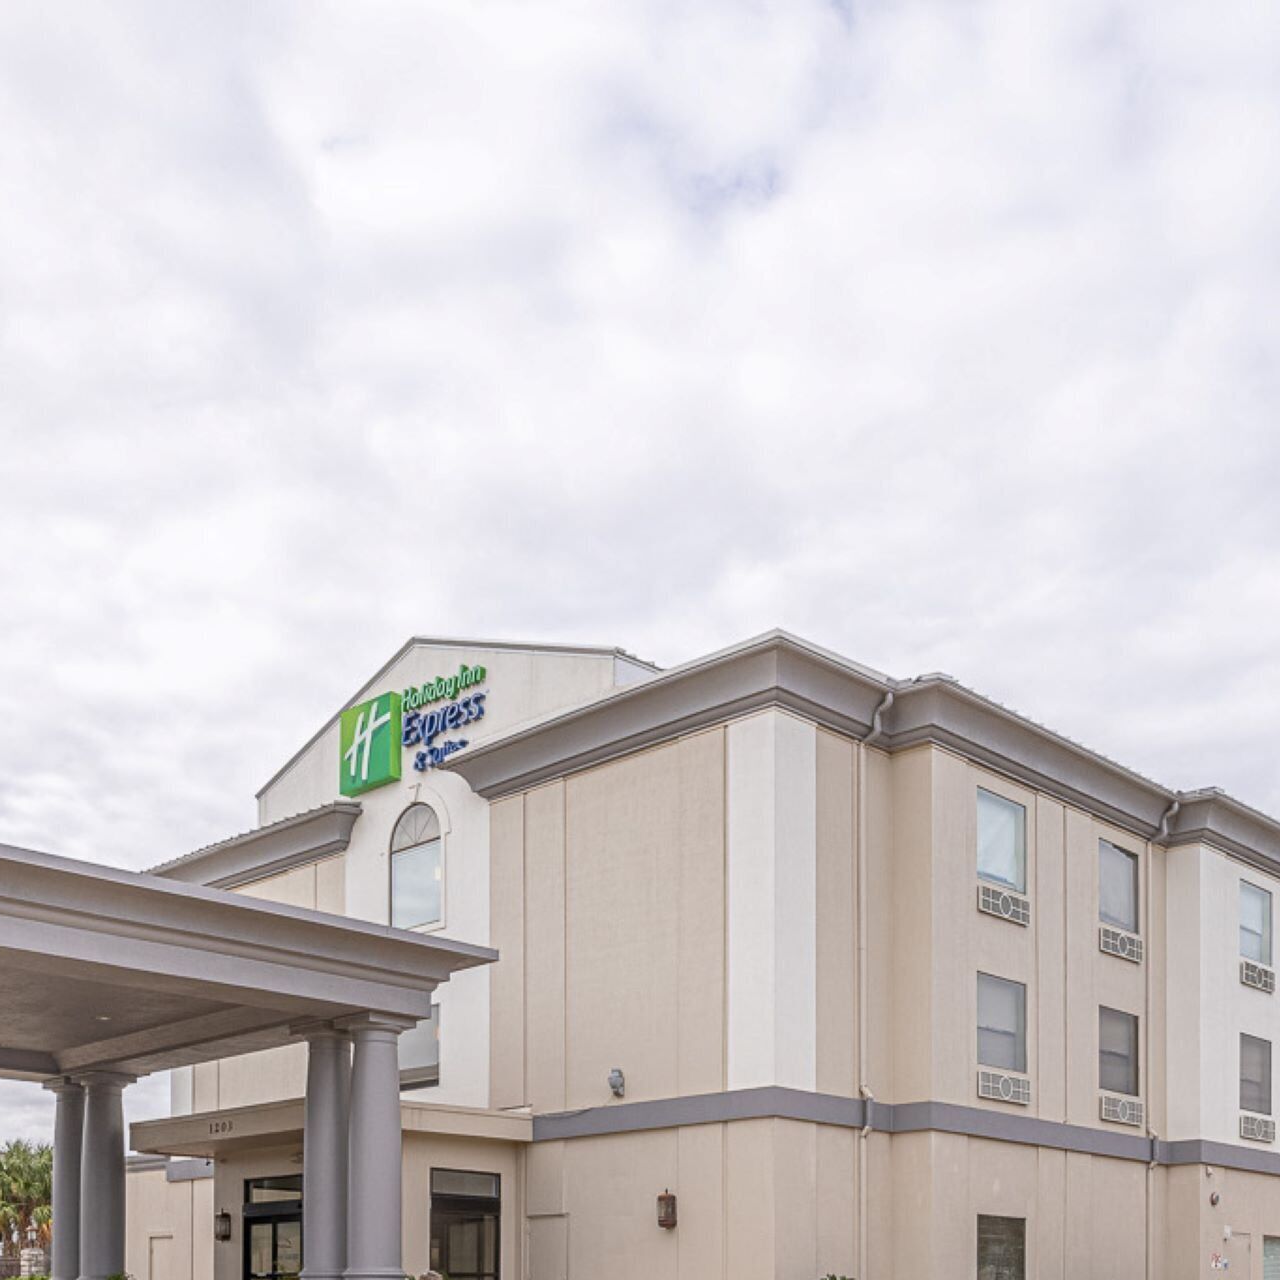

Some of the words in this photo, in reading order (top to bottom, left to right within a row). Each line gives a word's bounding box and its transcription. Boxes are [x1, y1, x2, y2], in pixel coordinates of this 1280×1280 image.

[401, 675, 458, 712] Holiday
[458, 664, 487, 690] Inn
[401, 692, 487, 747] Express
[414, 751, 427, 772] &
